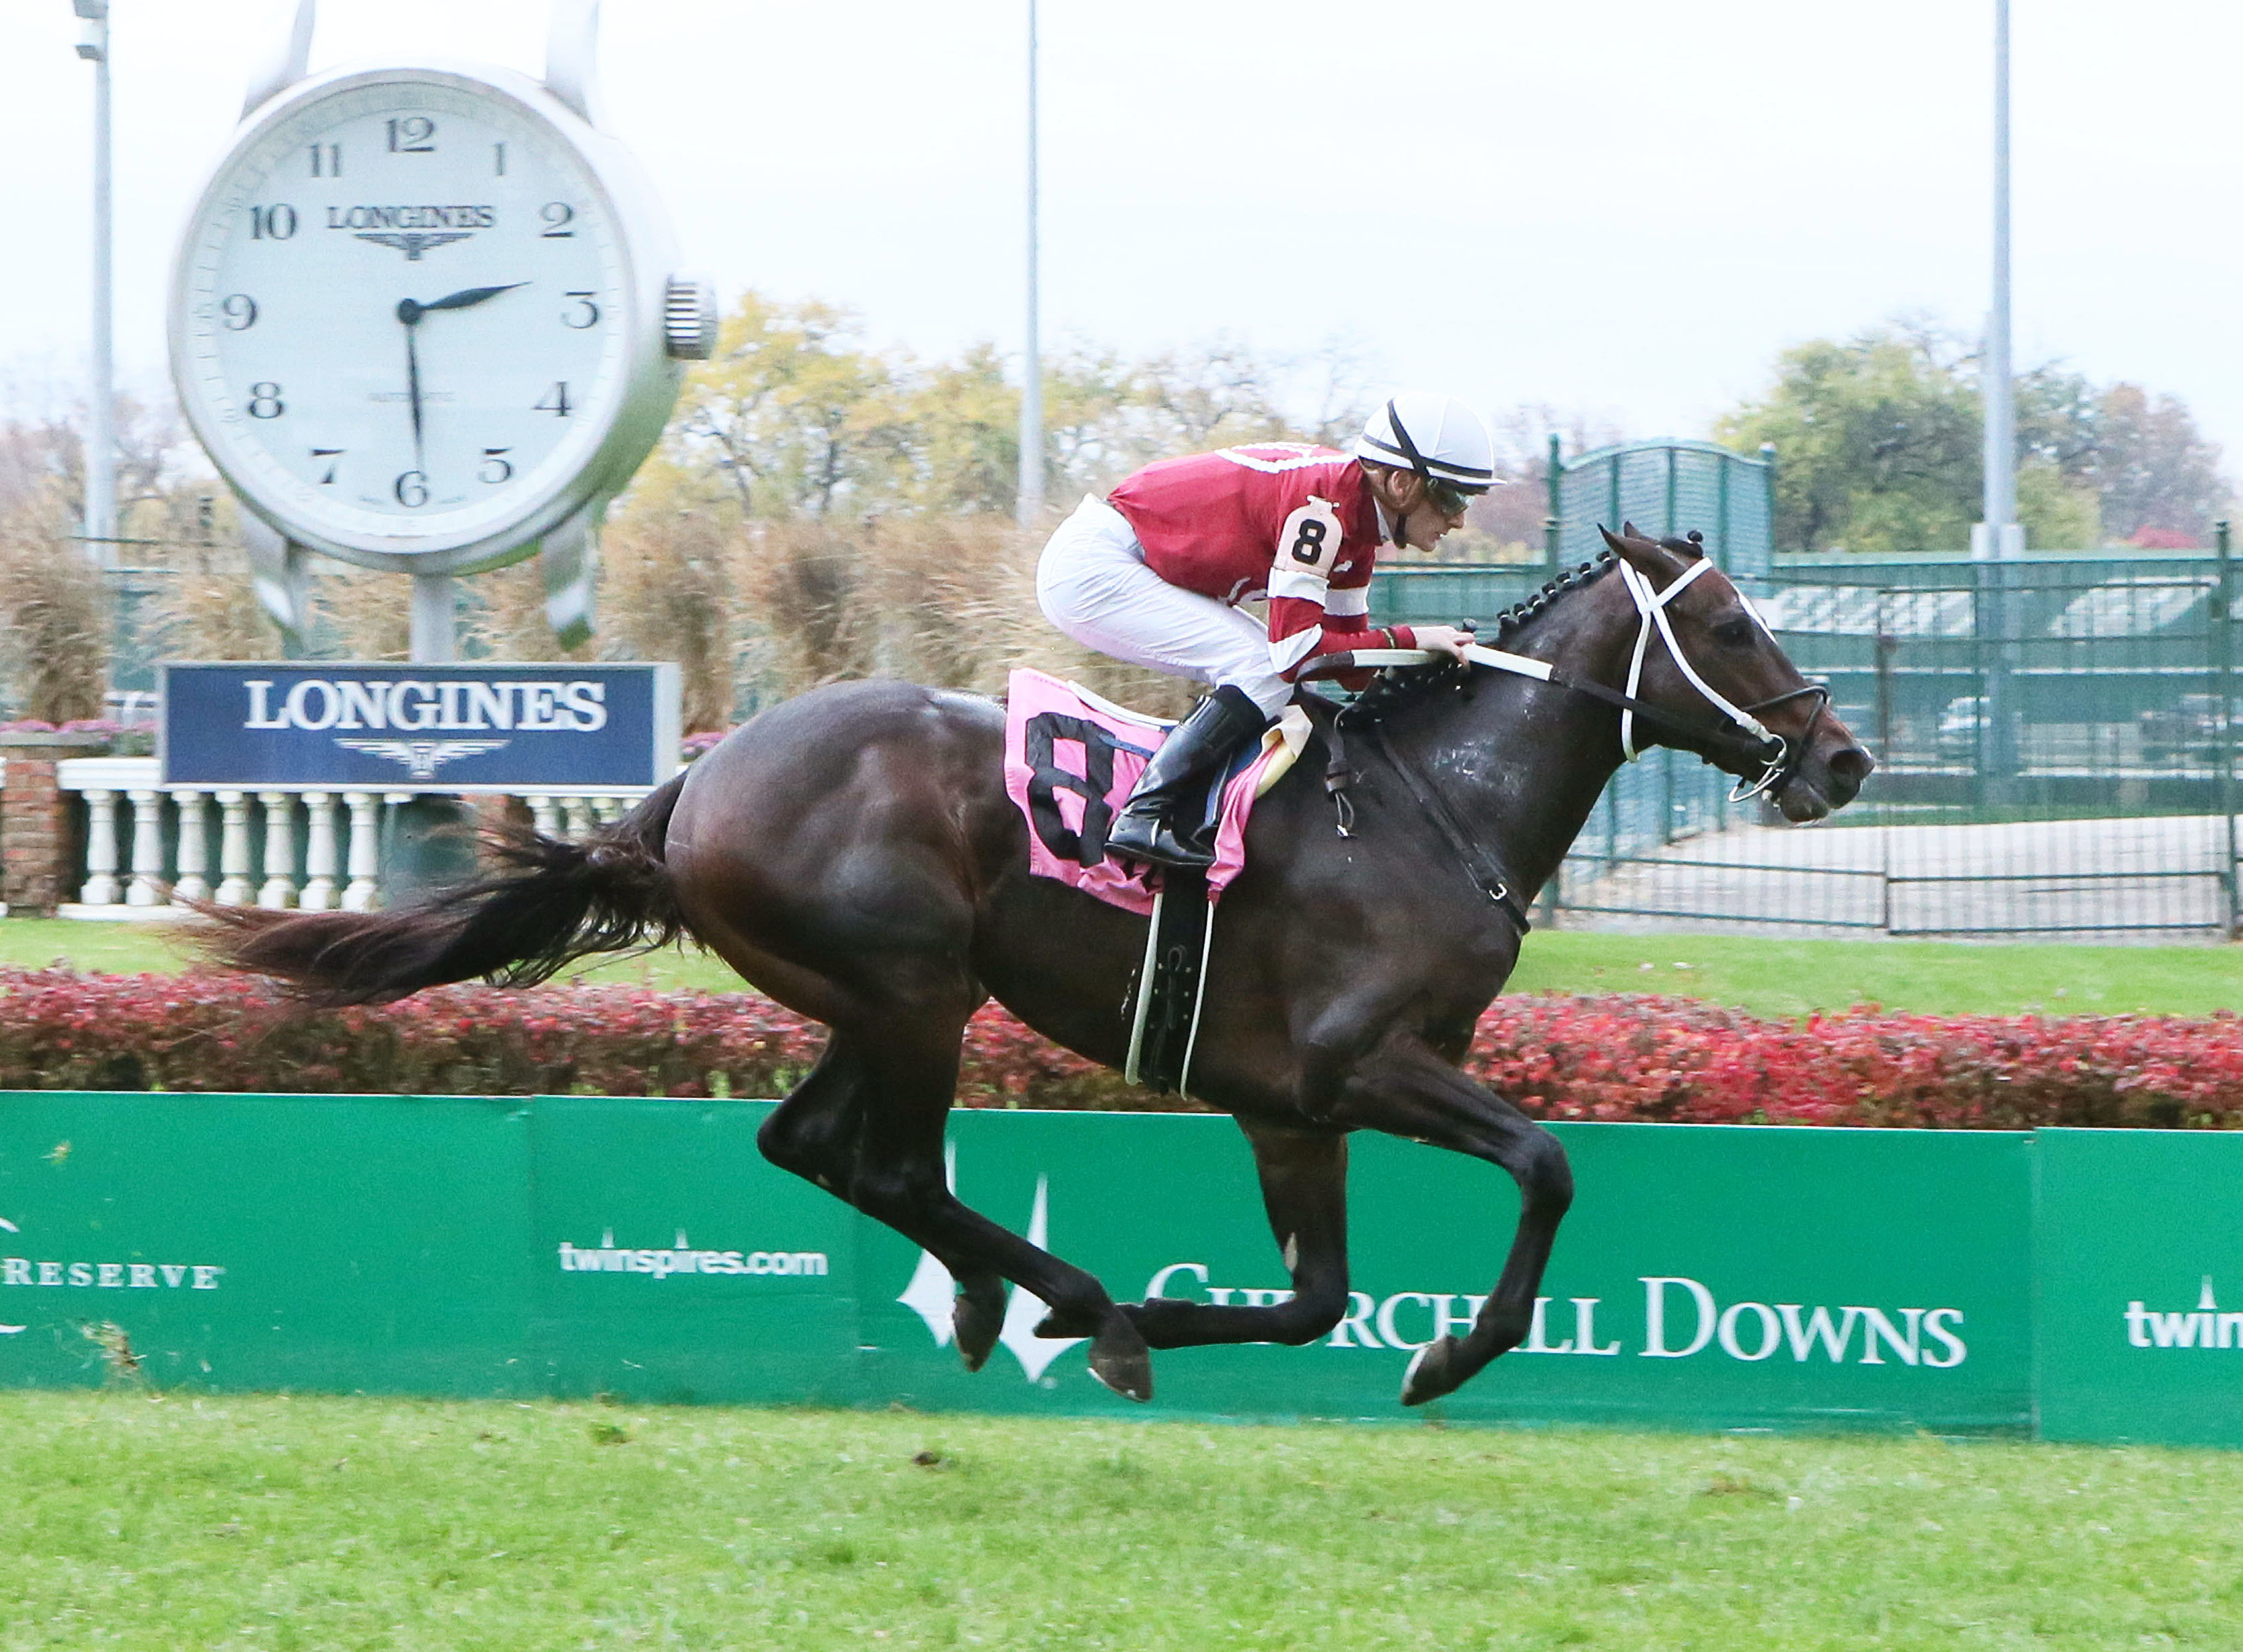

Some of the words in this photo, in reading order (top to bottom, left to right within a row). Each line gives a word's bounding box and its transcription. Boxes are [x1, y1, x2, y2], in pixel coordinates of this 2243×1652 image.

[385, 117, 435, 153] 12
[309, 142, 342, 177] 11
[492, 142, 507, 177] 1
[250, 203, 298, 240] 10
[327, 205, 496, 229] LONGINES
[541, 202, 574, 238] 2
[223, 294, 258, 331] 9
[562, 292, 600, 329] 3
[248, 382, 285, 420] 8
[533, 381, 572, 418] 4
[311, 448, 345, 485] 7
[479, 447, 513, 485] 5
[393, 470, 429, 507] 6
[1292, 519, 1327, 566] 8
[243, 680, 607, 732] LONGINES
[1025, 712, 1116, 868] 8
[558, 1227, 829, 1279] twinspires.com
[0, 1257, 227, 1290] RESERVE
[1638, 1277, 1967, 1369] DOWNS
